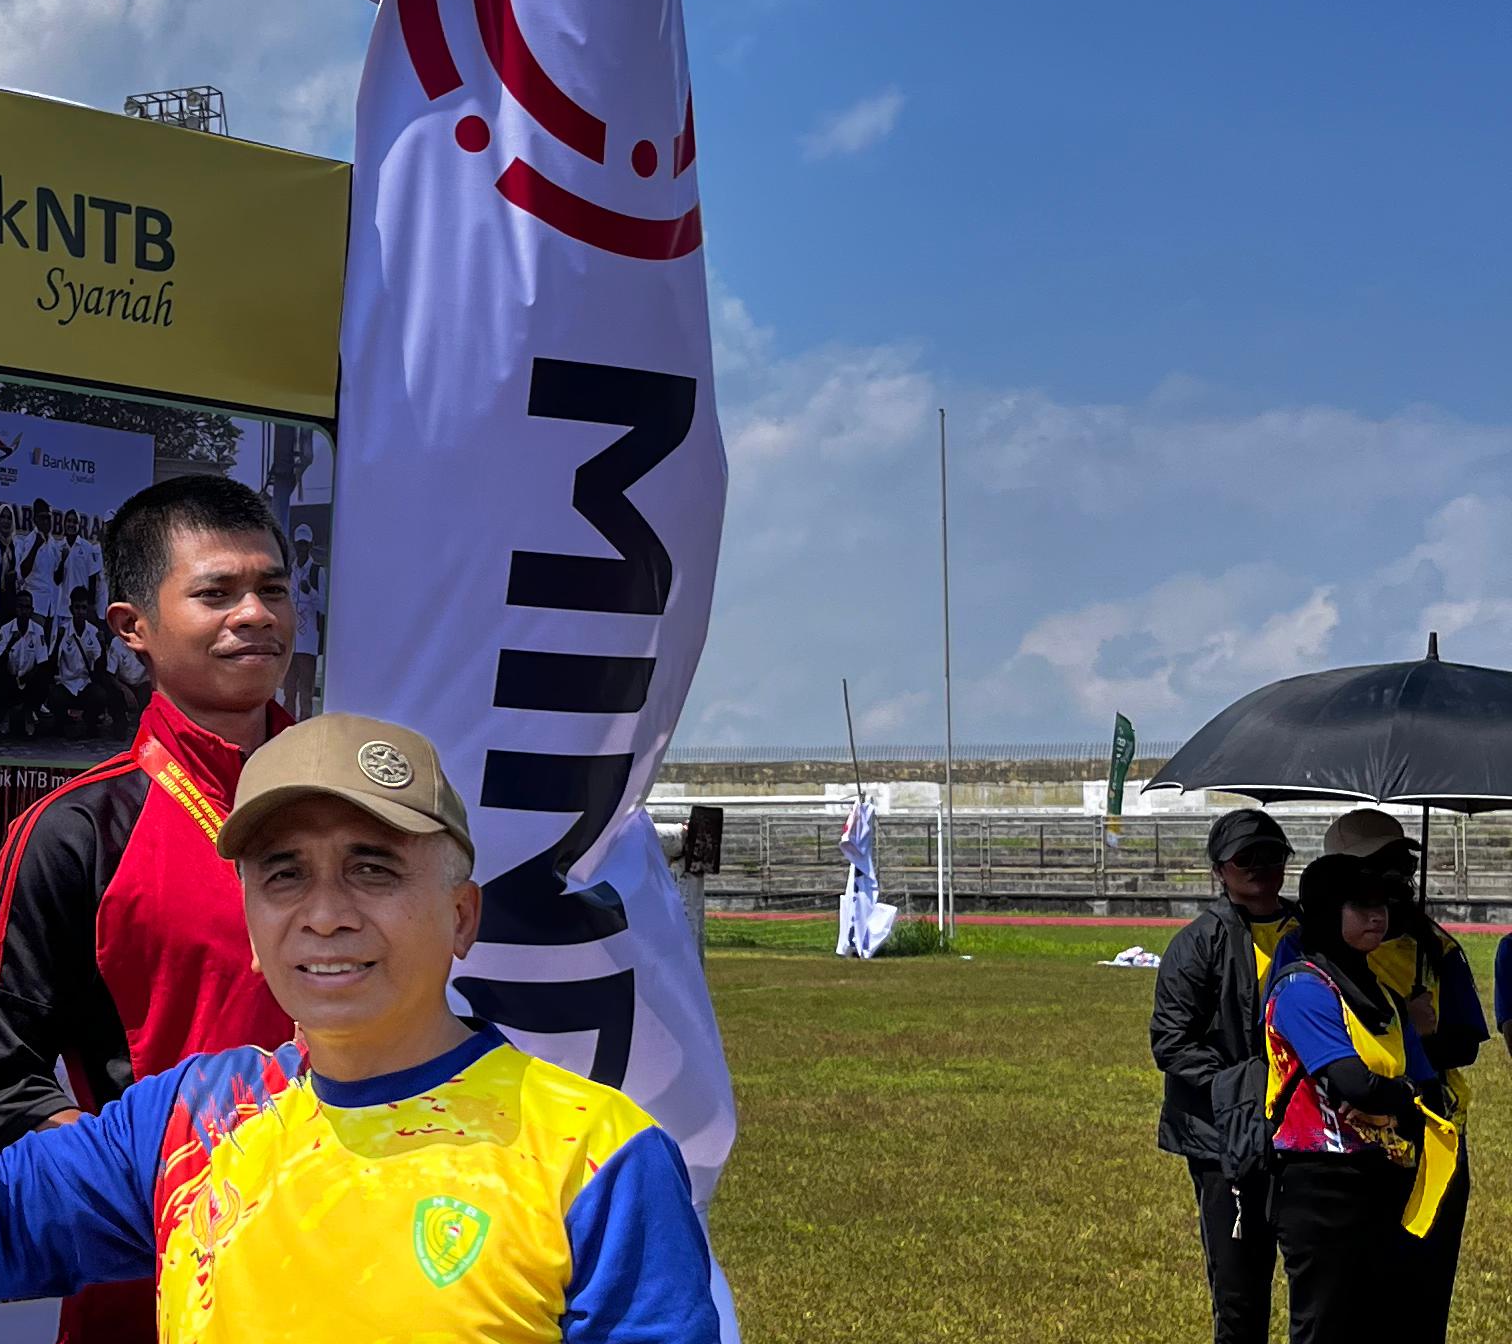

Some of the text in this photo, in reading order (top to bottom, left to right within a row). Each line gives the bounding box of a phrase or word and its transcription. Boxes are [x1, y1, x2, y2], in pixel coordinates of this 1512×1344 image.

[37, 267, 174, 326] Syariah
[42, 454, 96, 474] BankNTB
[16, 769, 49, 788] NTB
[167, 761, 185, 779] 2025
[432, 1196, 478, 1218] NTB
